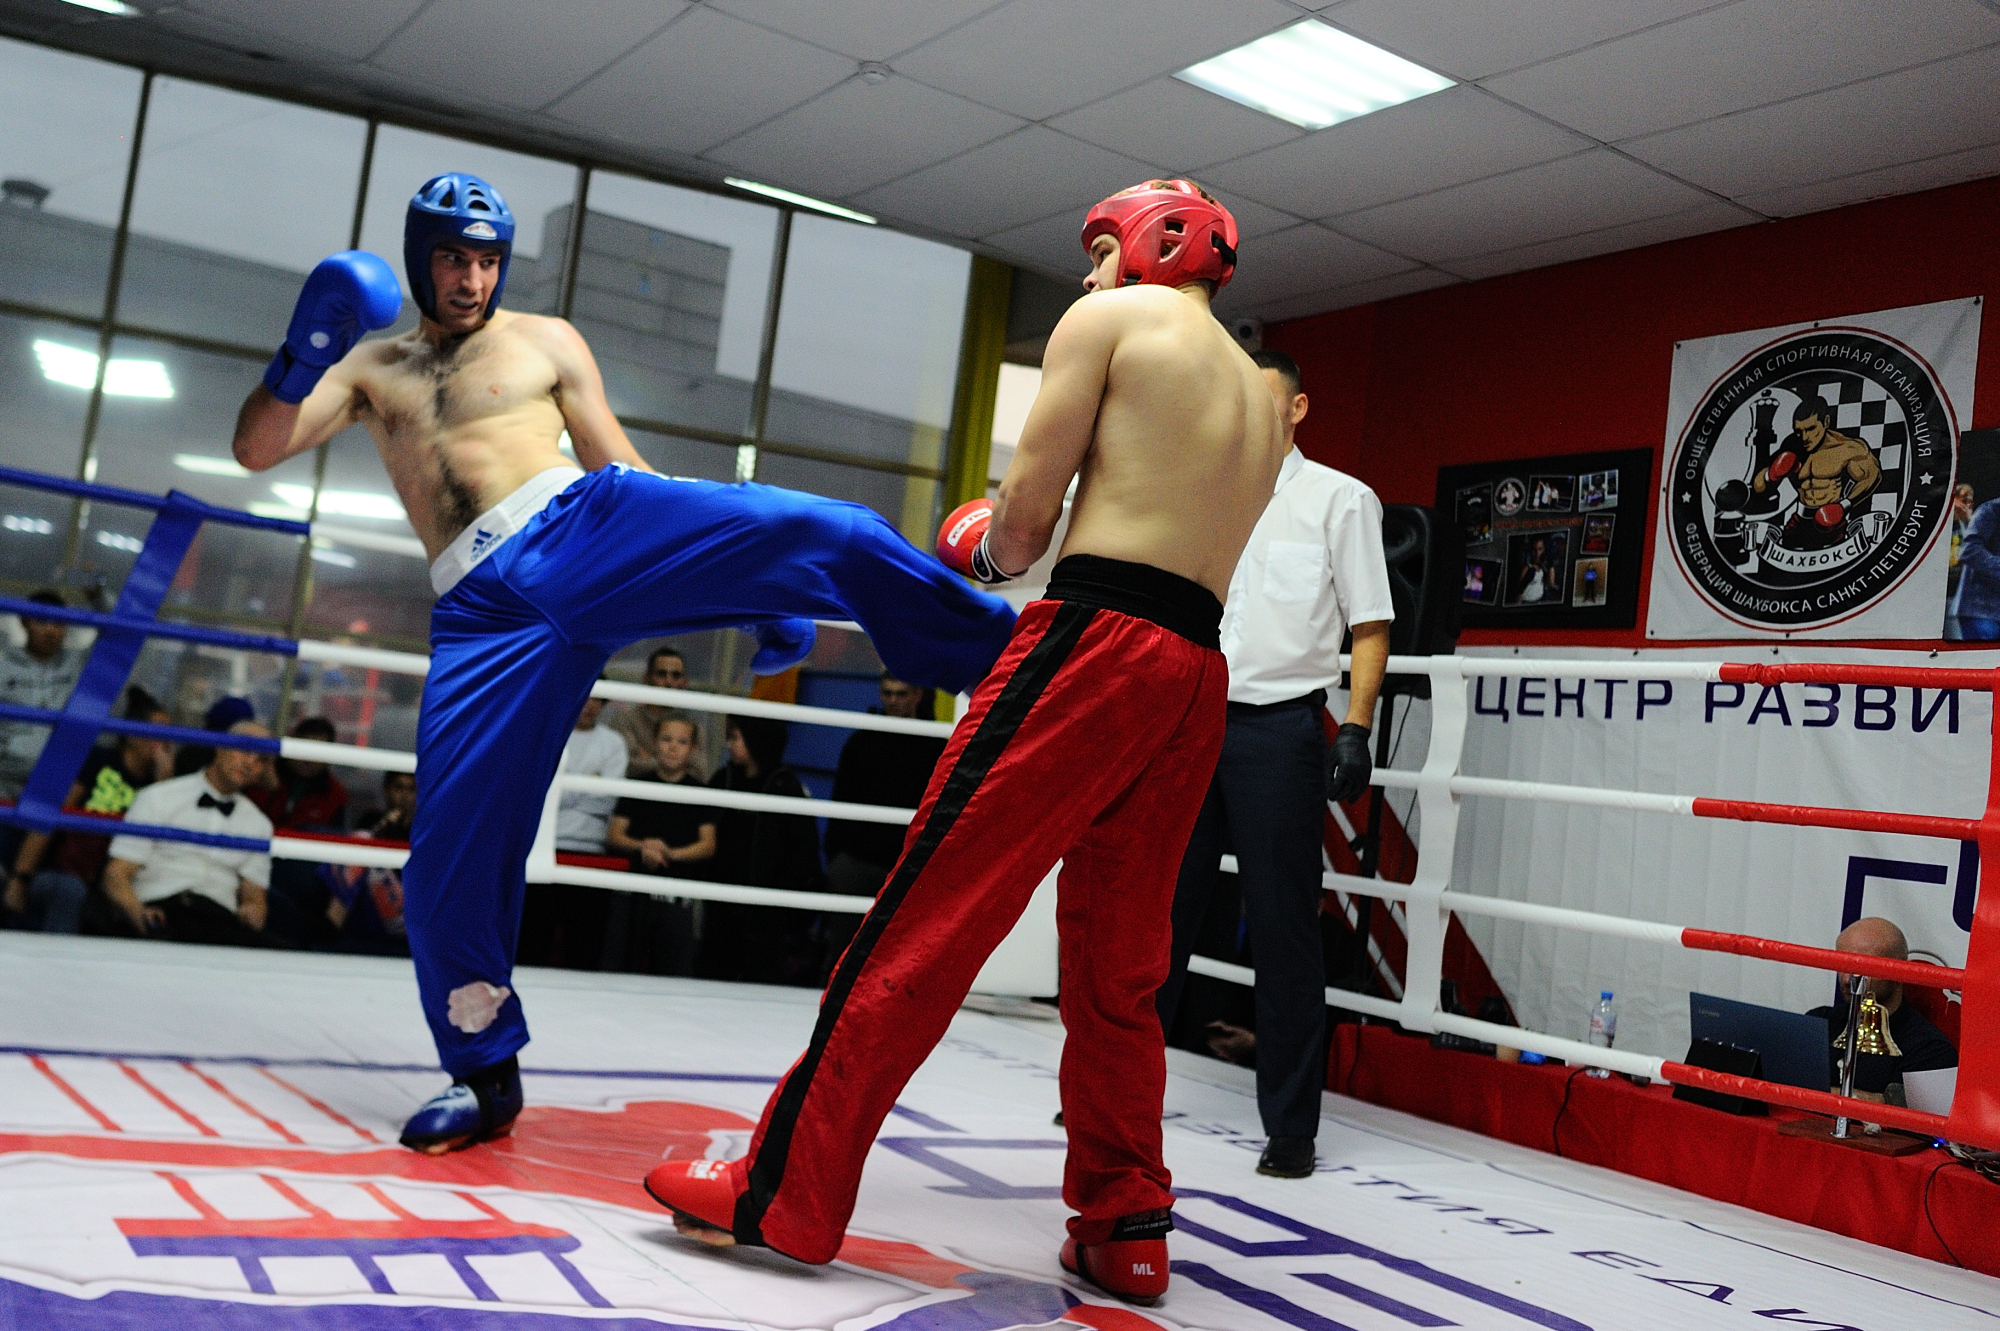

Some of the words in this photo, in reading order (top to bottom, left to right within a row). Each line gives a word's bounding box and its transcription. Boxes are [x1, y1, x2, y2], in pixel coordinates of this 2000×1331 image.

[1685, 369, 1764, 480] ОБЩЕСТВЕННАЯ
[1766, 344, 1872, 372] СПОРТИВНАЯ
[1874, 358, 1932, 458] ОРГАНИЗАЦИЯ
[1685, 522, 1733, 596] ФЕДЕРАЦИЯ
[1733, 590, 1812, 614] ШАХБОКСА
[1817, 500, 1929, 609] САНКТ-ПЕТЕРБУРГ
[1771, 544, 1857, 568] ШАХБОКС
[1475, 675, 1673, 723] ЦЕНТР
[1704, 680, 1993, 735] РАЗВИ
[1132, 1262, 1156, 1276] ML
